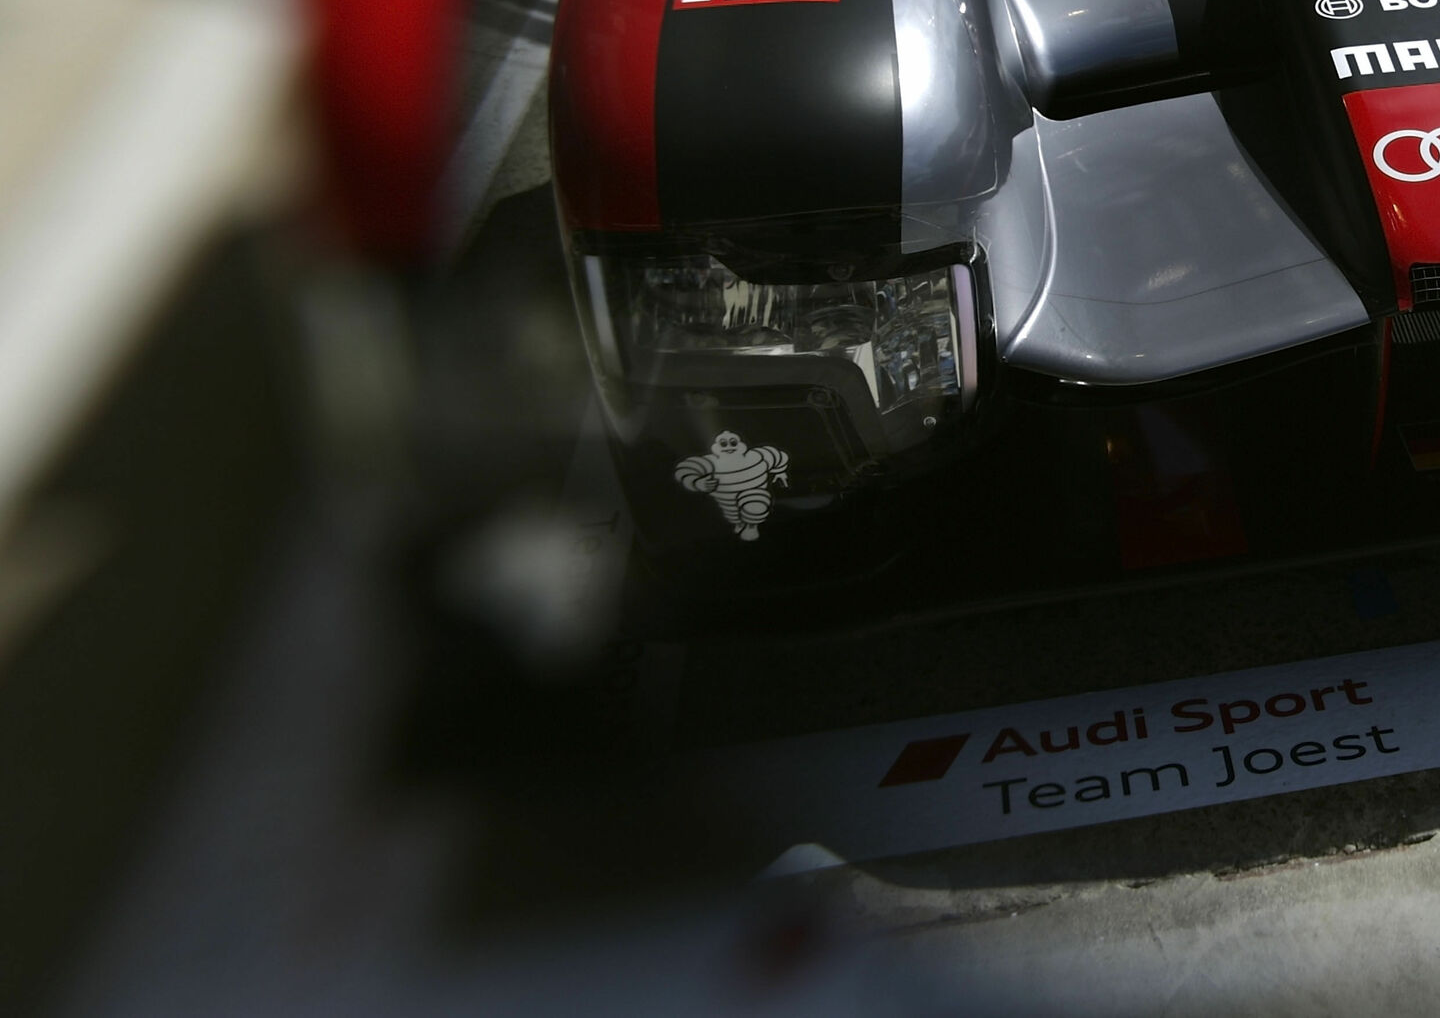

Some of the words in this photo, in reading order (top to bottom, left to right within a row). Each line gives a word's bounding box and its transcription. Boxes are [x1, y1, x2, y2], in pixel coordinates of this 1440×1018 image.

[981, 708, 1148, 763] Audi
[1169, 678, 1373, 735] Sport
[982, 760, 1190, 815] Team
[1211, 725, 1400, 788] Joest
